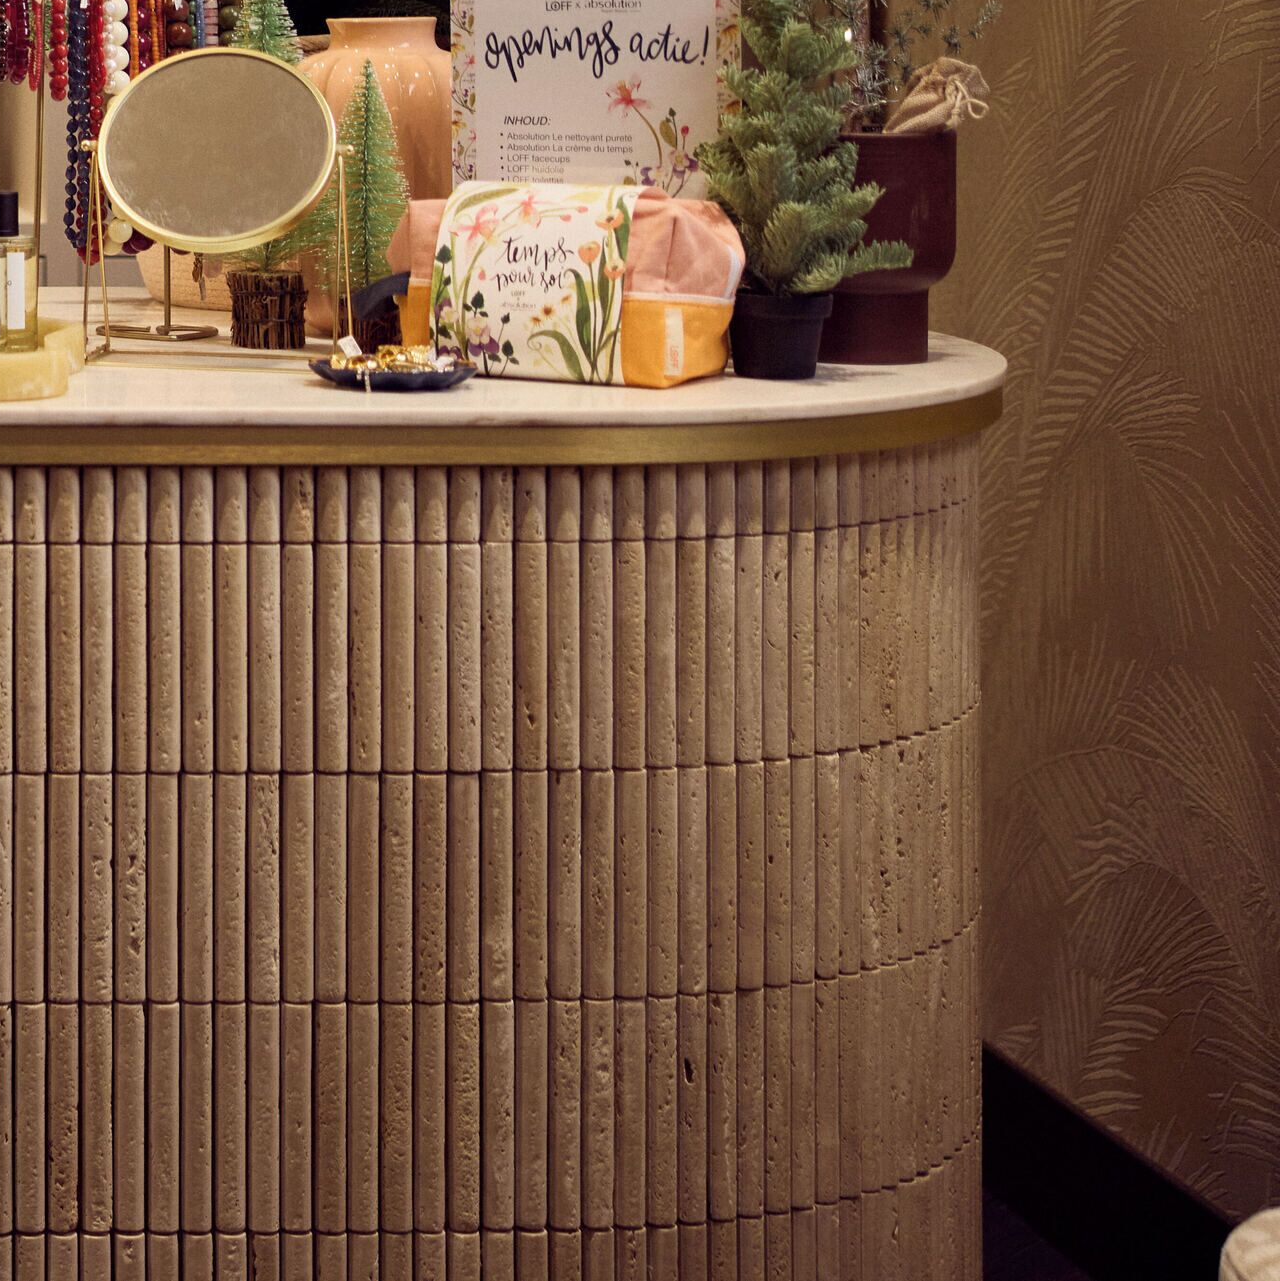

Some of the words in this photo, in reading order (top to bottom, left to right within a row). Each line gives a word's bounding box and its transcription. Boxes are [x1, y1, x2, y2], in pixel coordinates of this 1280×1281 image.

[545, 0, 573, 12] LOFF
[584, 0, 642, 9] absolution
[485, 20, 621, 83] openings
[629, 23, 709, 66] actie!
[503, 115, 551, 126] INHOUD:
[507, 132, 550, 141] Absolution
[552, 133, 562, 141] Le
[565, 133, 603, 143] nettoyant
[507, 143, 550, 152] Absolution
[552, 144, 563, 152] La
[593, 144, 605, 153] du
[607, 145, 633, 154] temps
[507, 154, 529, 162] LOFF
[507, 165, 529, 173] LOFF
[496, 236, 574, 271] temps
[490, 266, 534, 292] pour
[540, 266, 563, 294] soi
